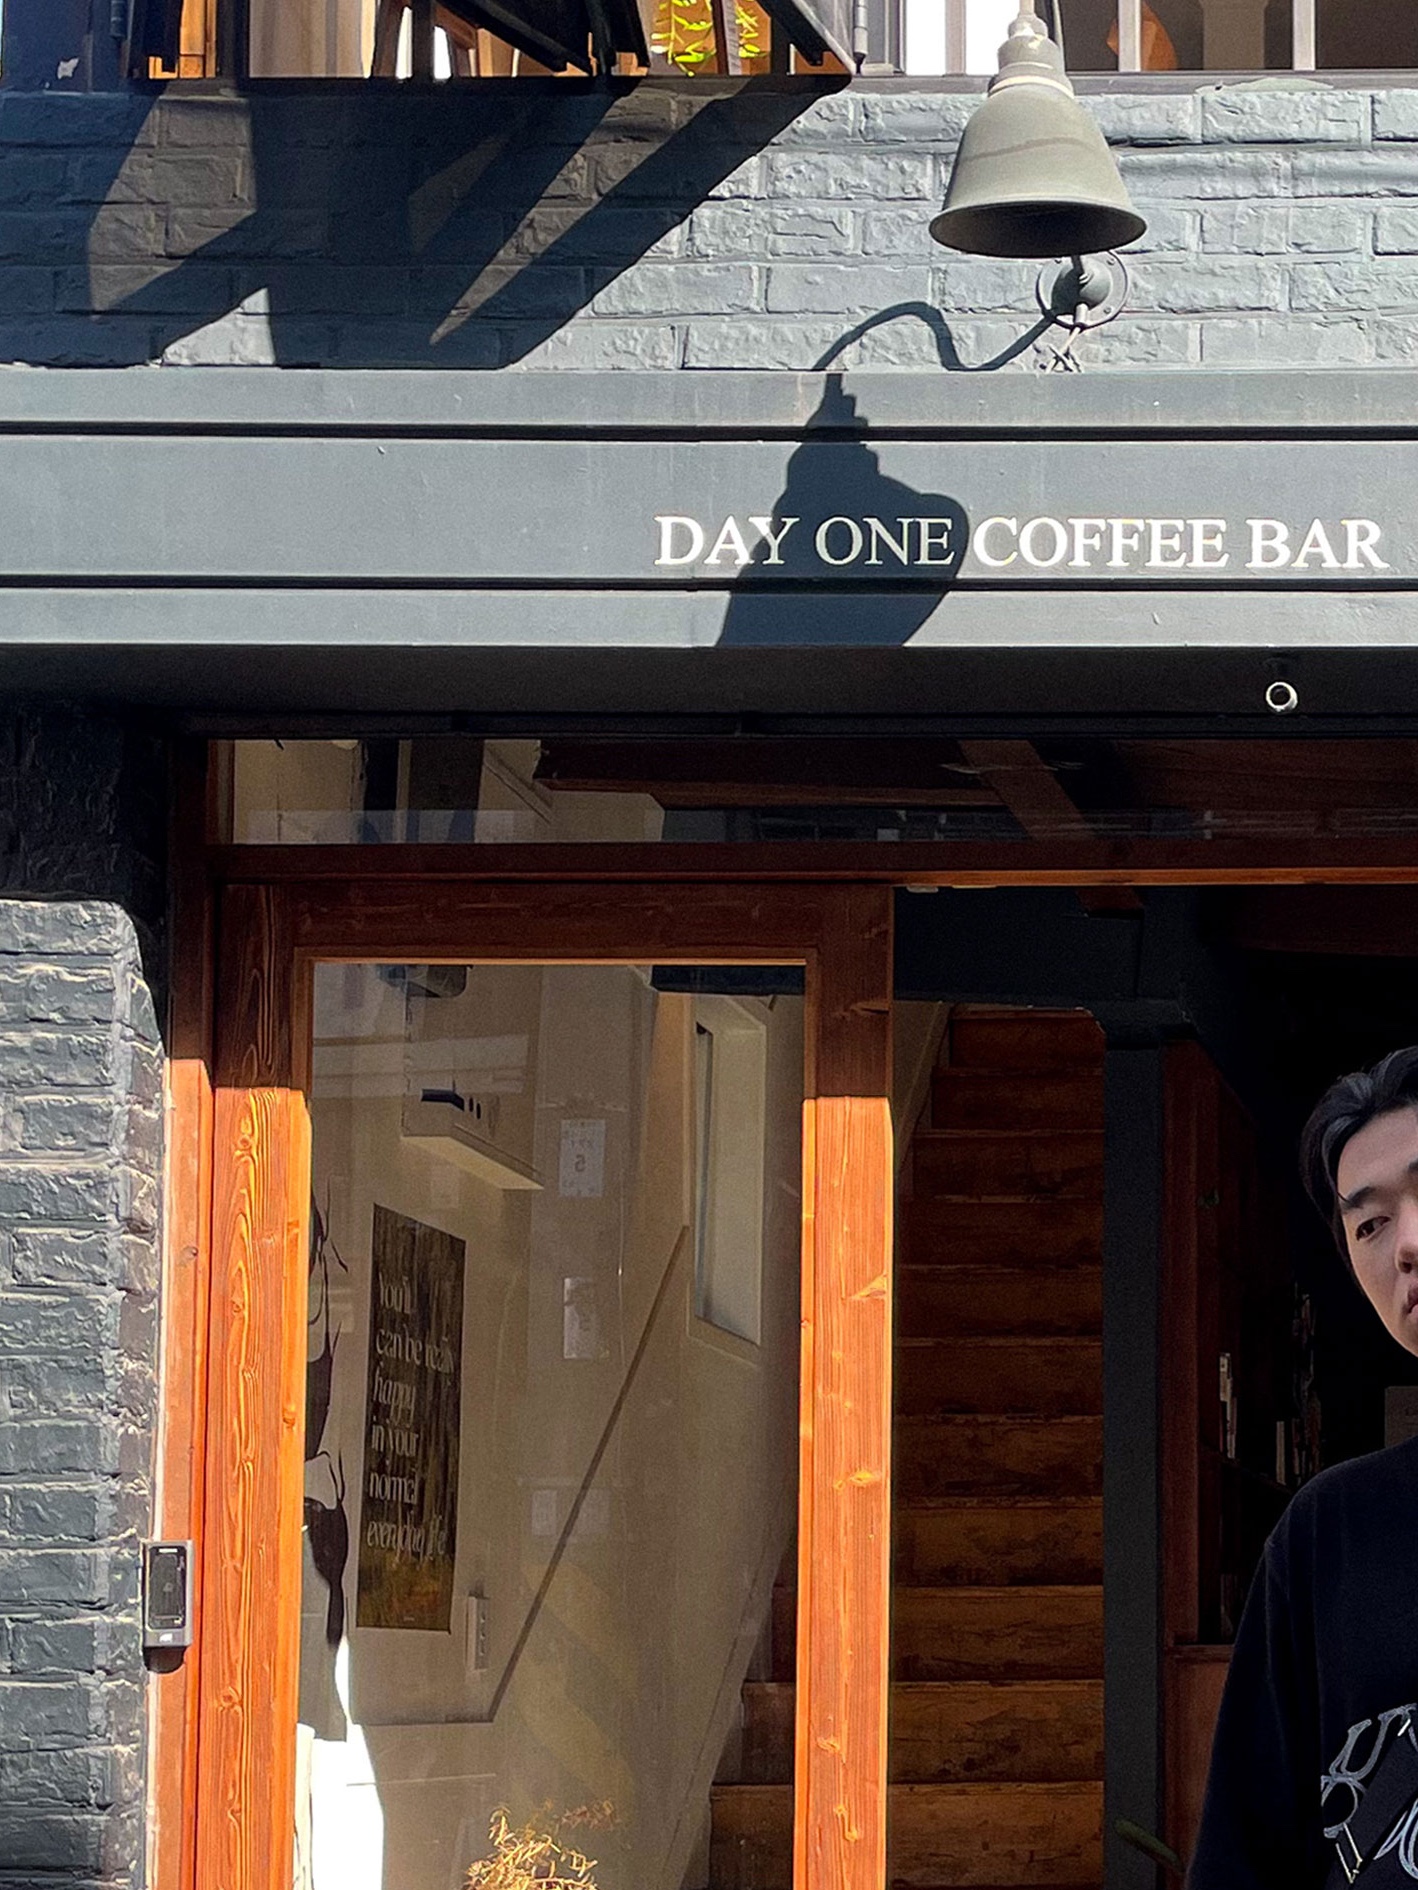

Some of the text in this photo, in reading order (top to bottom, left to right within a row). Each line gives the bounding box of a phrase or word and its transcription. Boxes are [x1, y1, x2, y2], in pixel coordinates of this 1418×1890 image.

[654, 515, 1390, 570] DAY ONE COFFEE BAR
[373, 1361, 417, 1427] happy
[371, 1415, 419, 1463] in your
[369, 1465, 418, 1505] normal
